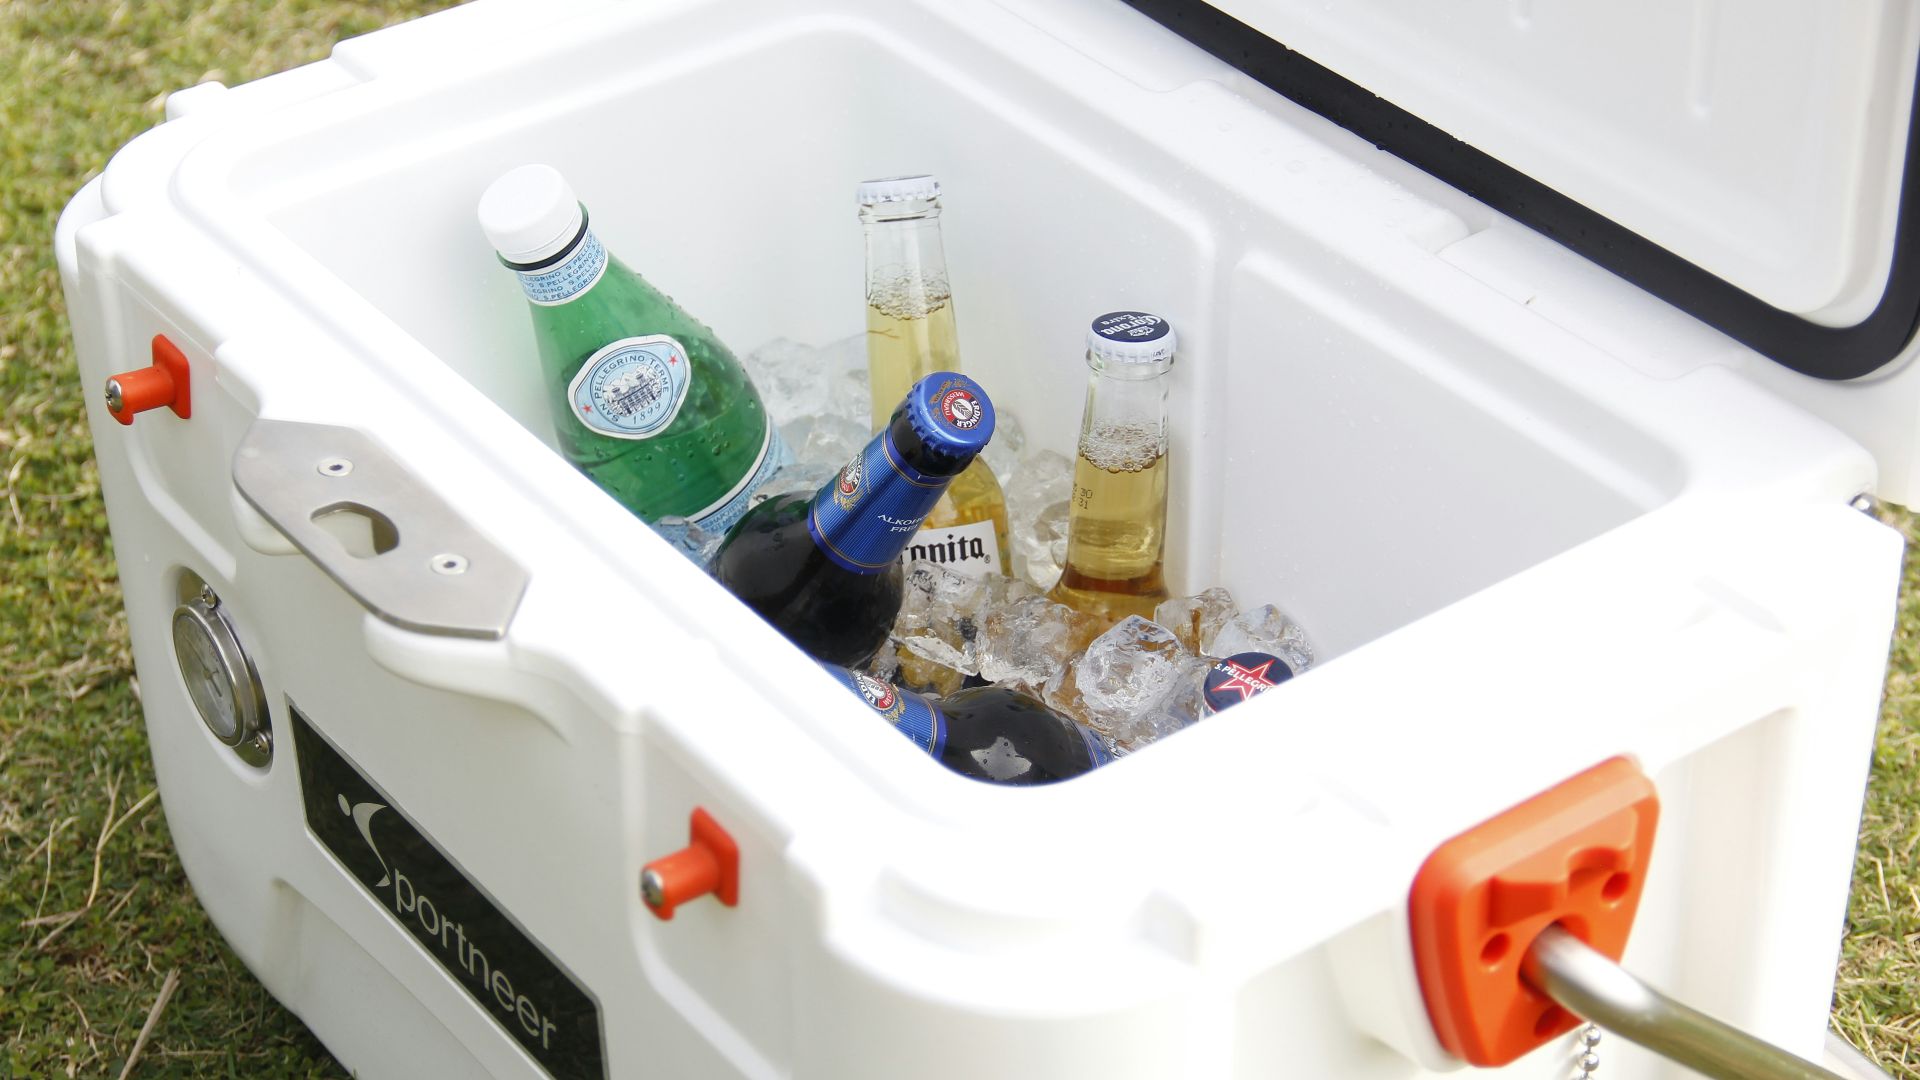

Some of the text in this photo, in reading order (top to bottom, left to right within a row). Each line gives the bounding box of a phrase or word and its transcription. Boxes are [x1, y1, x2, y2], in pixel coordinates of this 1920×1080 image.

[1100, 315, 1162, 335] Corona
[594, 354, 670, 422] SAN PELLEGRINO TERME
[633, 401, 661, 425] 1899
[956, 400, 981, 428] ERDINGER
[1213, 662, 1272, 695] S.PELLEGRI
[338, 794, 557, 1050] Sportneer
